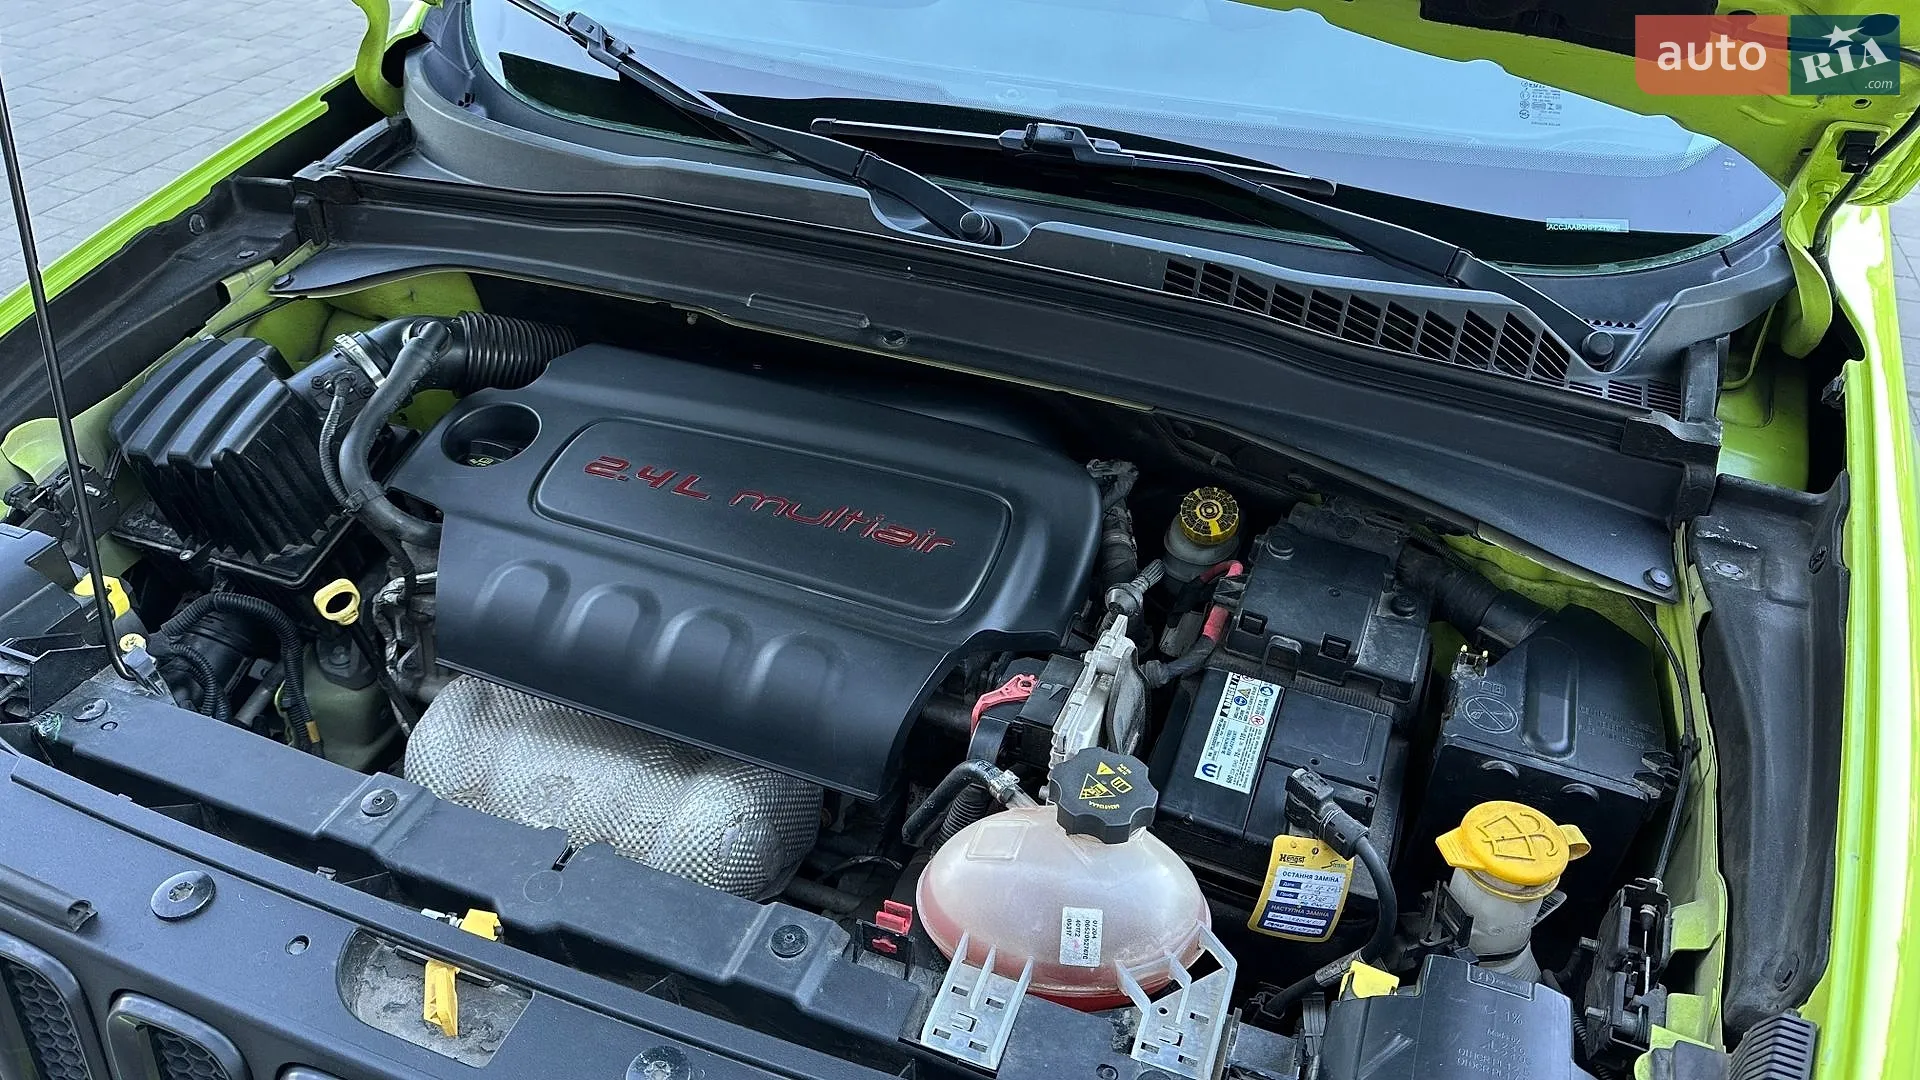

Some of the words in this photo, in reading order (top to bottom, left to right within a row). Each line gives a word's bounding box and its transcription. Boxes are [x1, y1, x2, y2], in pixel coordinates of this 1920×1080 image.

[728, 488, 956, 553] multiair
[1282, 871, 1313, 880] ОСТАННЯ
[1314, 874, 1339, 883] ЗАМІНА
[1271, 904, 1304, 914] НАСТУПНА
